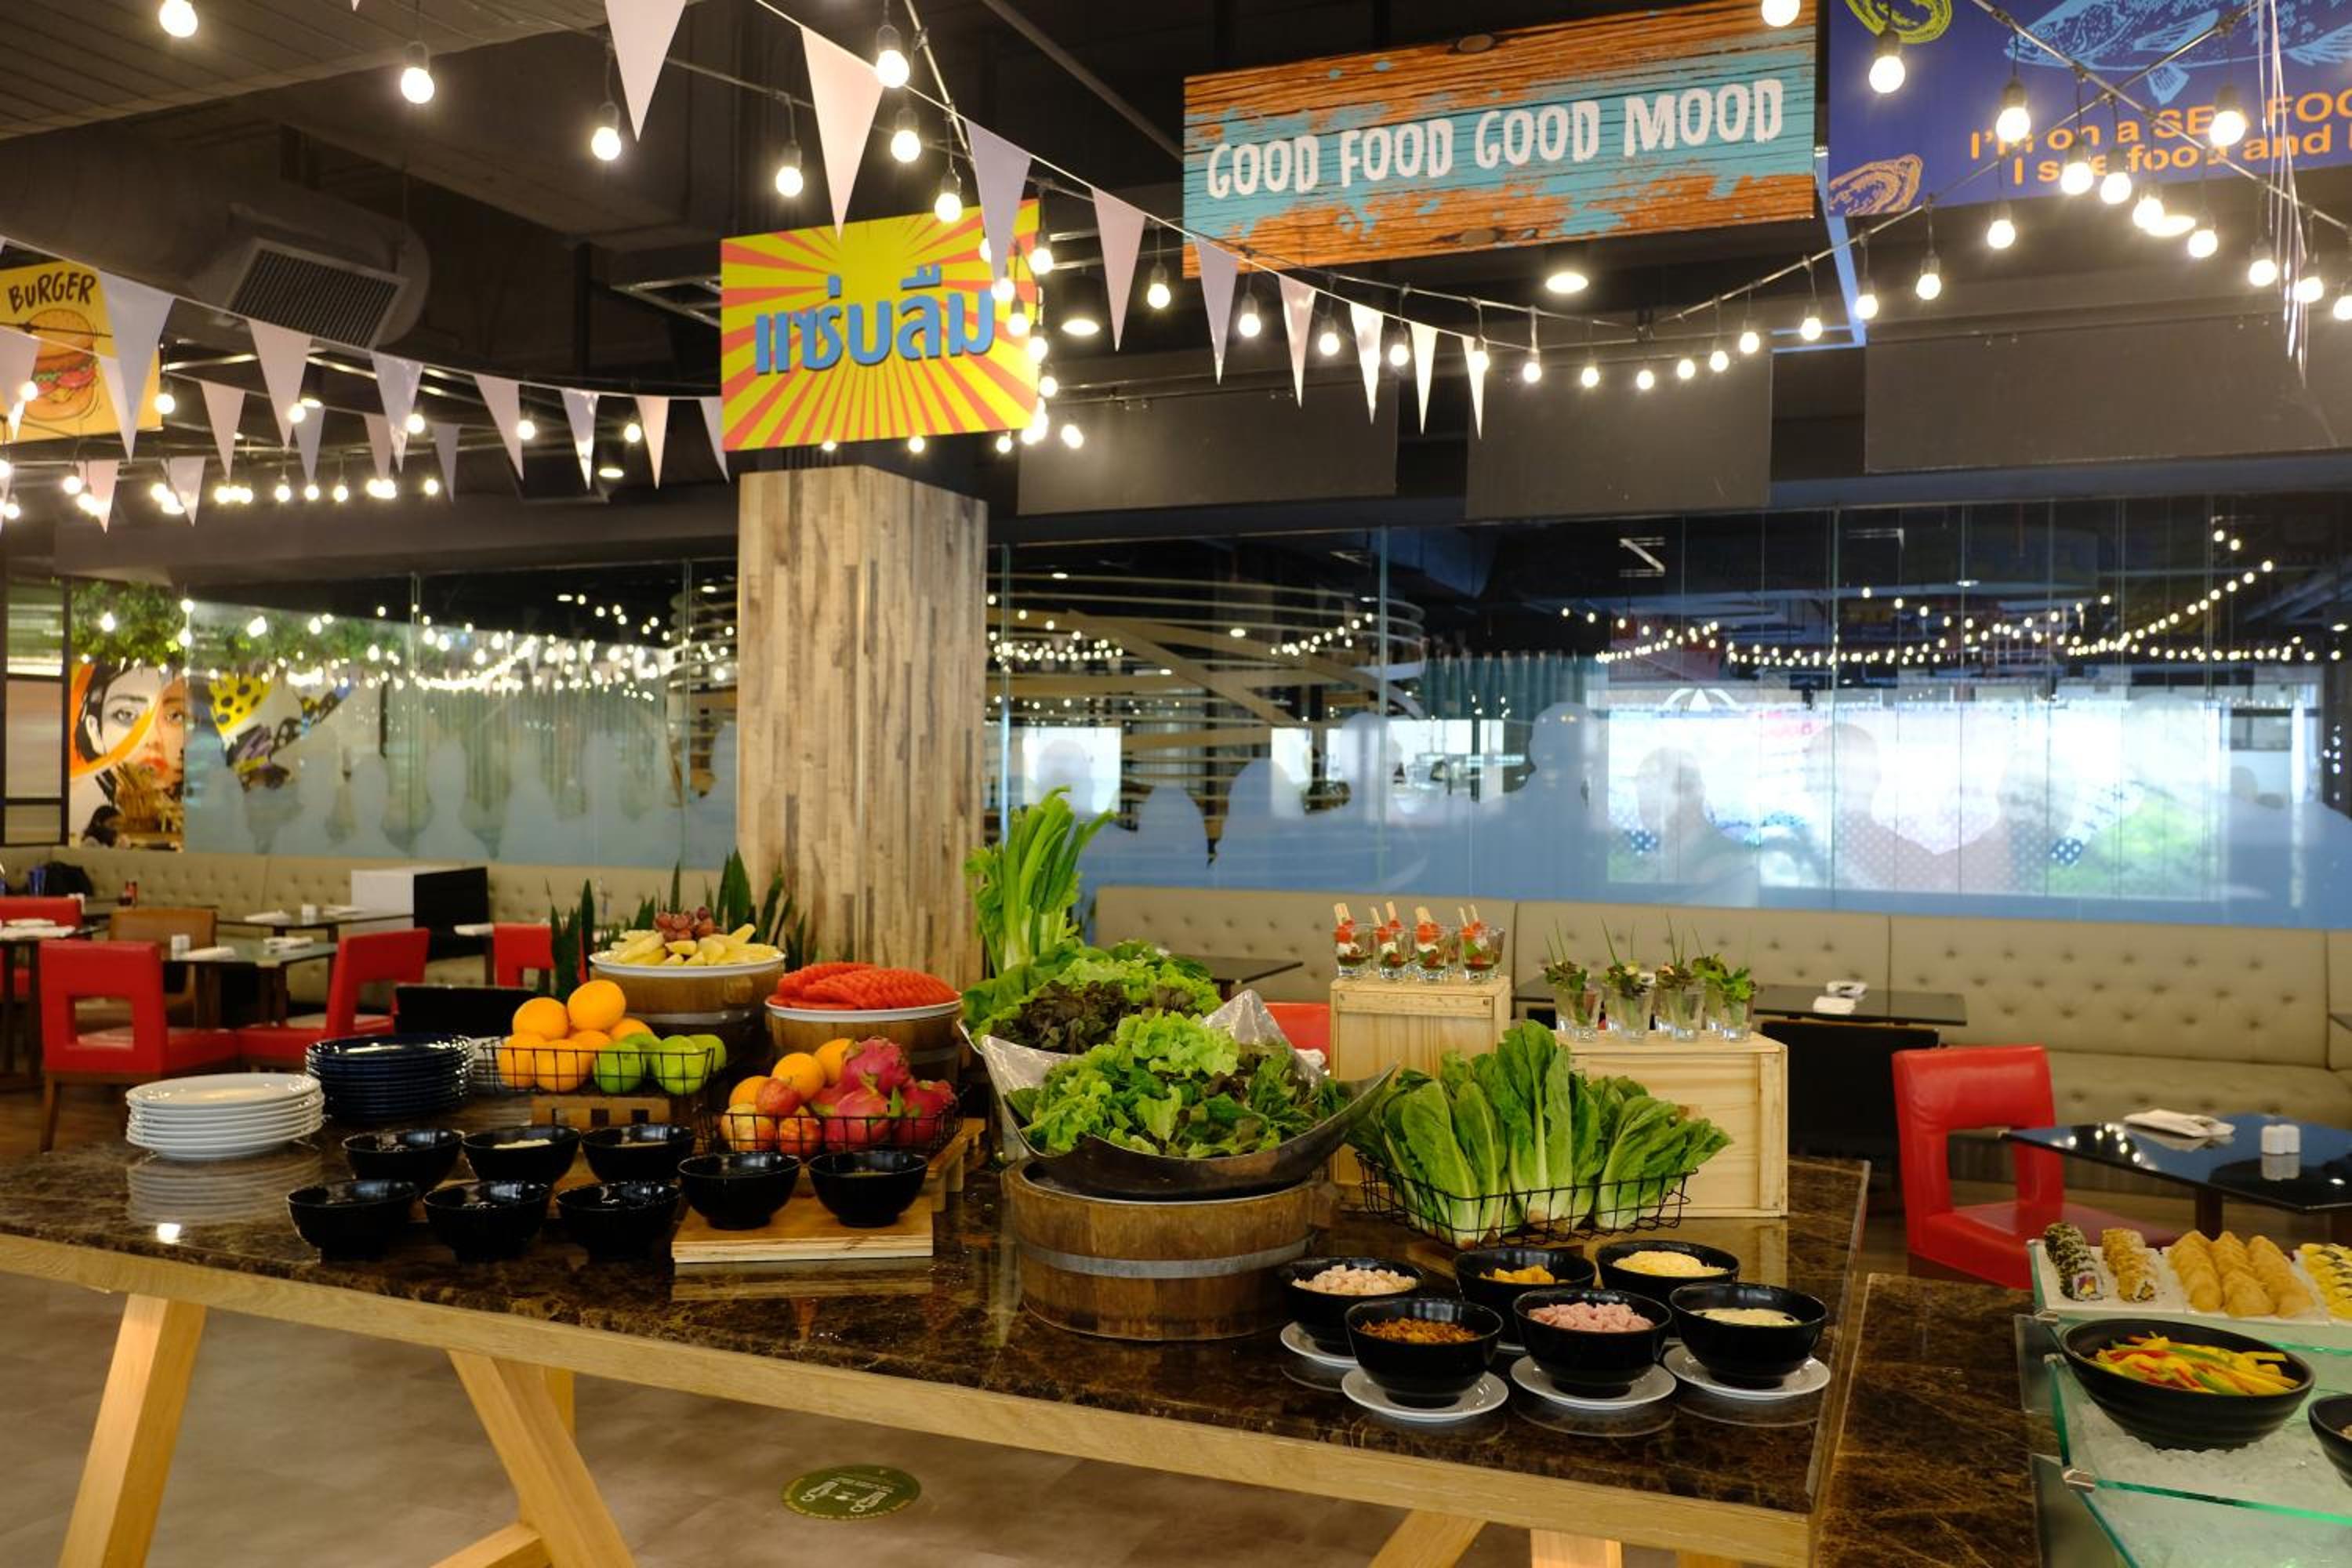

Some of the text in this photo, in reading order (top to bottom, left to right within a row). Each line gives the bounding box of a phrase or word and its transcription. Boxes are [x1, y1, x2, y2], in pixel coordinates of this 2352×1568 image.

[1207, 78, 1782, 199] GOOD FOOD GOOD MOOD
[2014, 158, 2024, 185] I
[2038, 154, 2107, 182] se
[2243, 123, 2332, 161] and
[2047, 125, 2100, 150] on
[2118, 120, 2140, 143] a
[2154, 105, 2250, 139] SE
[8, 270, 96, 314] BURGER
